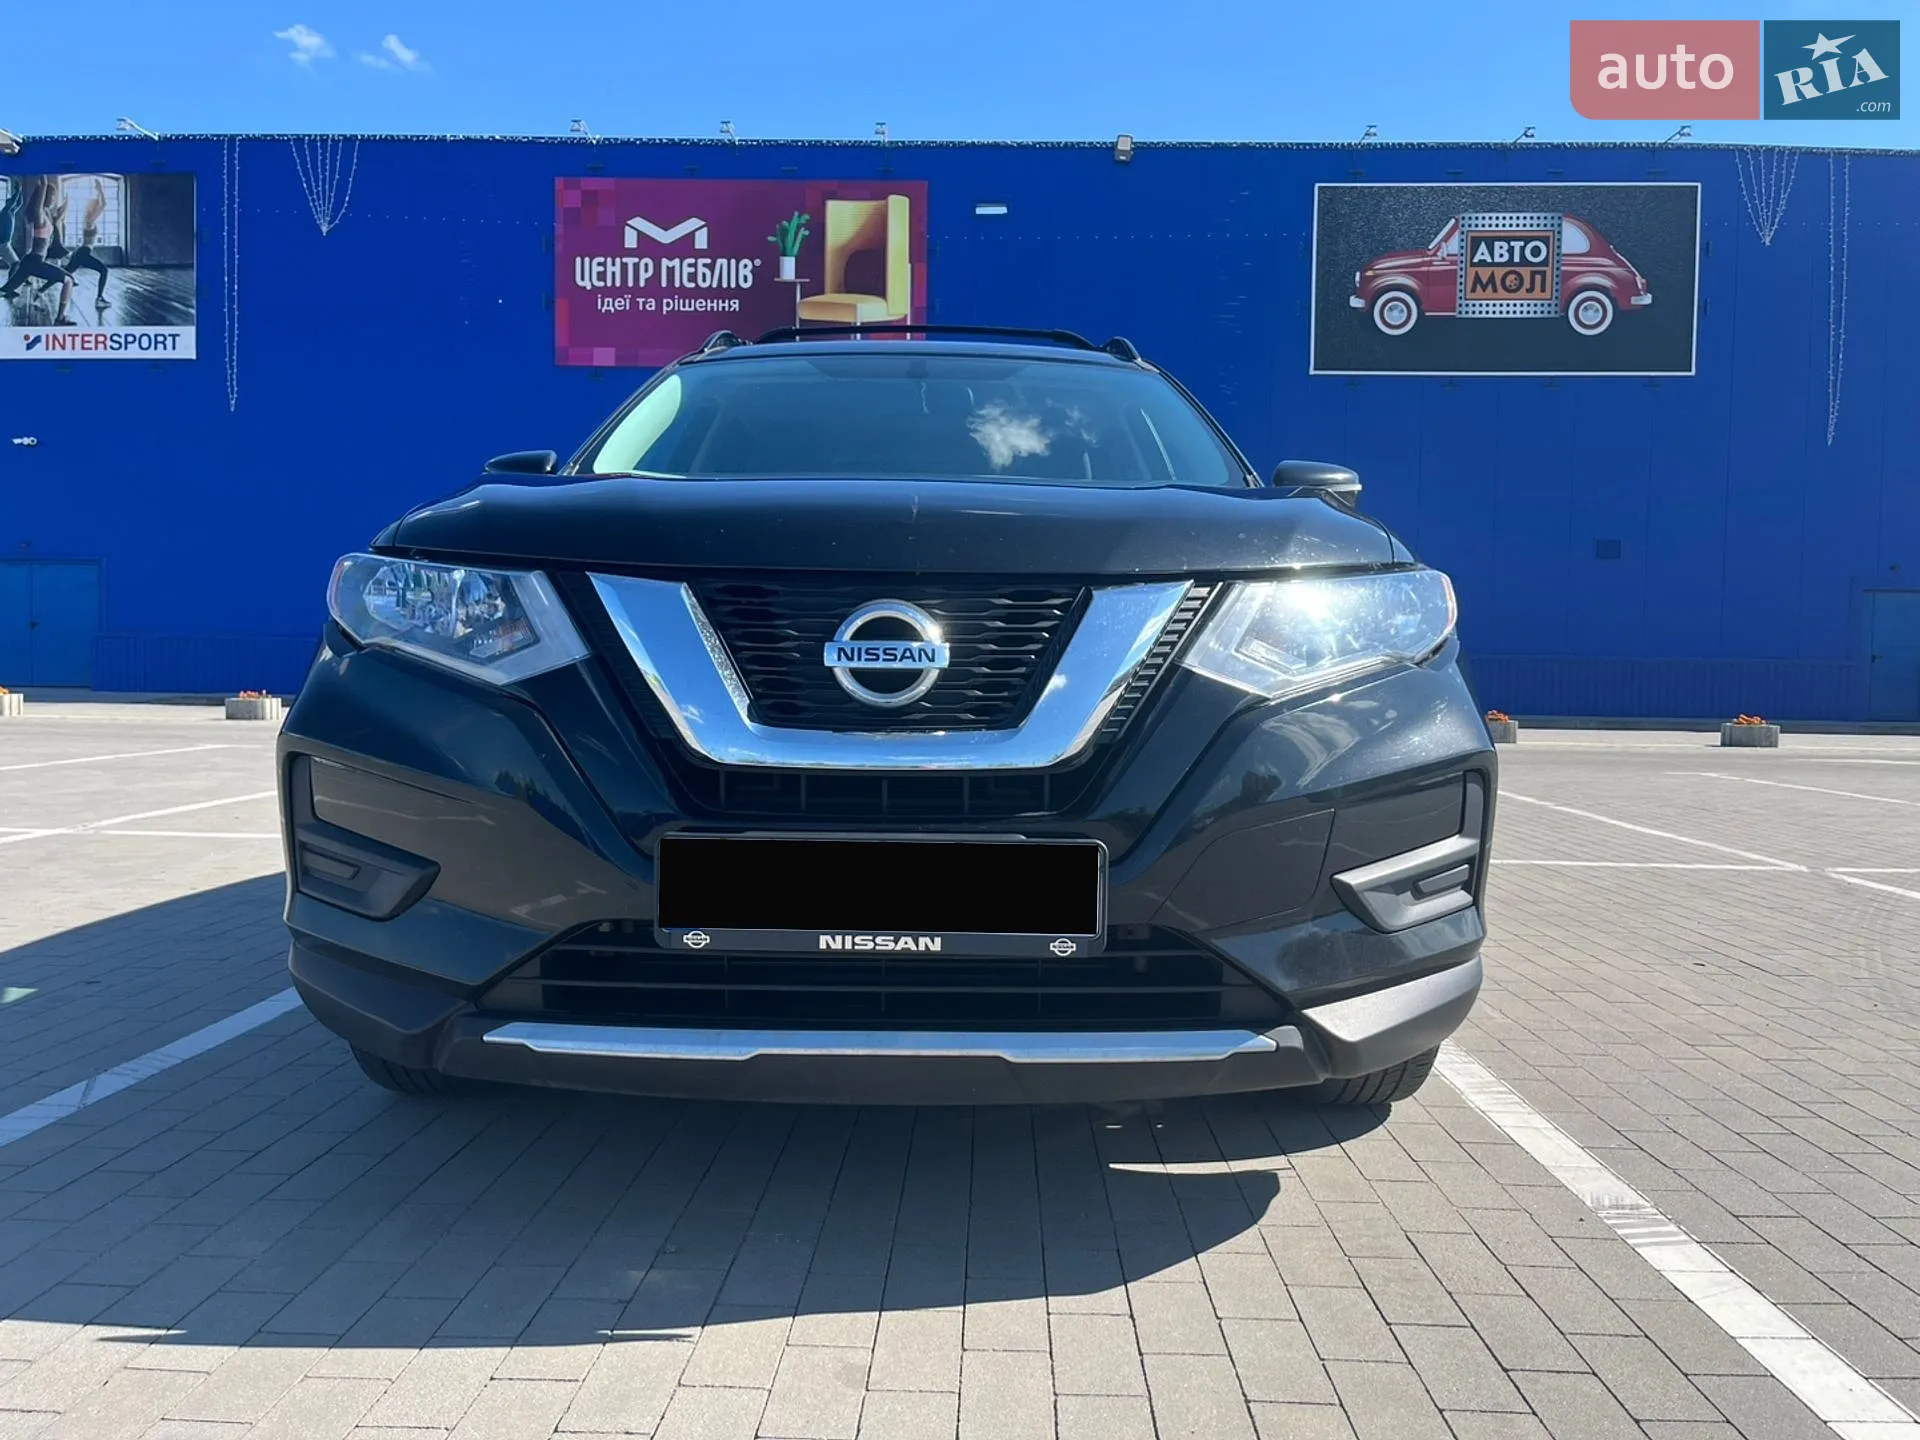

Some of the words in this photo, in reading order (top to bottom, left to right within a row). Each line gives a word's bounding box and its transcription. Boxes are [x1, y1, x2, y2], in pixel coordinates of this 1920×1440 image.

[1472, 240, 1548, 263] АВТО
[574, 256, 654, 290] ЦЕНТР
[660, 256, 753, 290] МЕБЛІВ
[1470, 269, 1547, 294] МОЛ
[596, 294, 631, 313] ідеї
[636, 298, 657, 312] та
[662, 294, 740, 315] рішення
[44, 333, 181, 351] INTERSPORT
[836, 646, 936, 663] NISSAN
[818, 933, 942, 952] NISSAN
